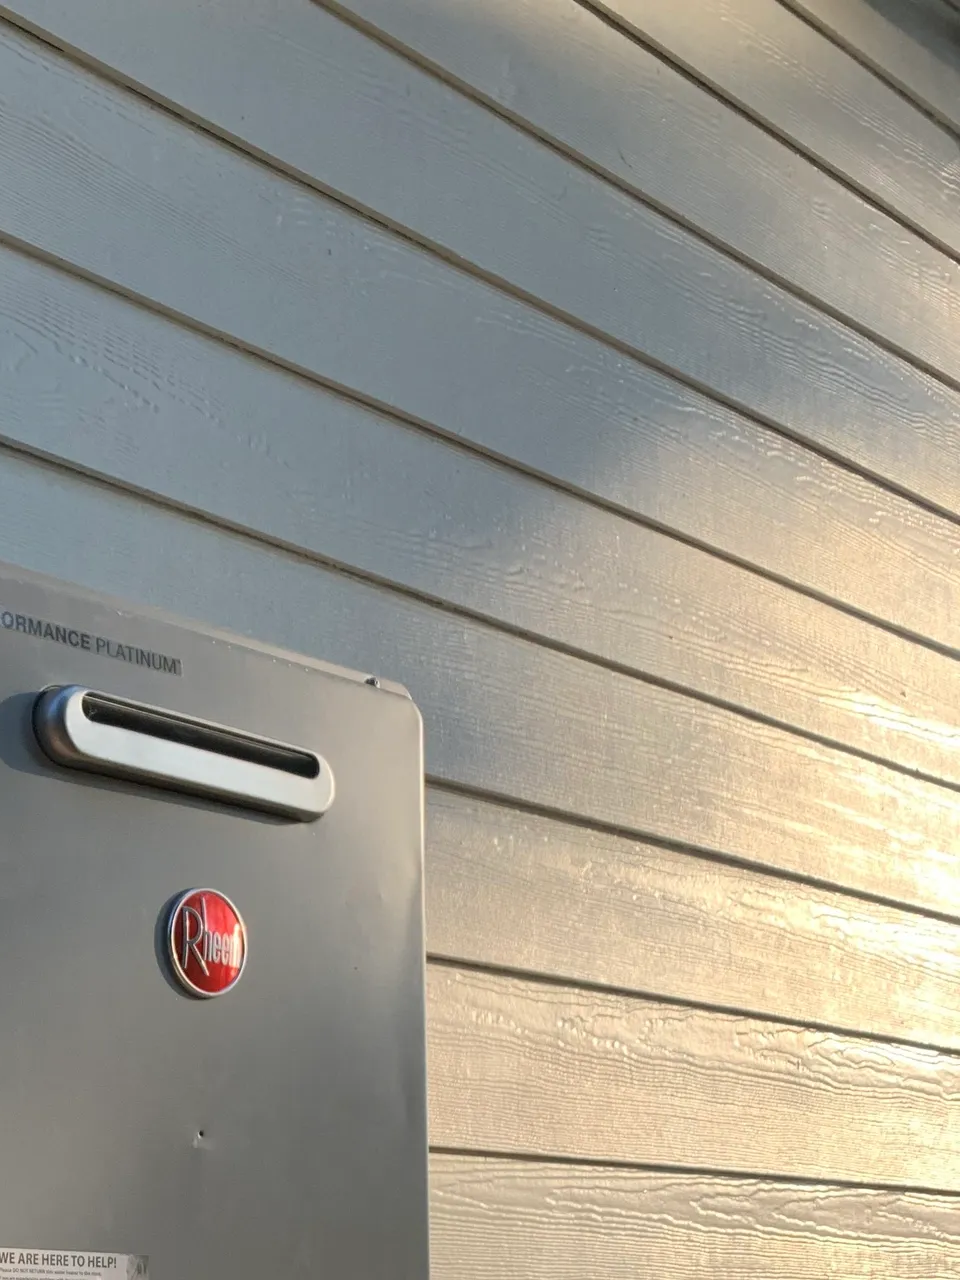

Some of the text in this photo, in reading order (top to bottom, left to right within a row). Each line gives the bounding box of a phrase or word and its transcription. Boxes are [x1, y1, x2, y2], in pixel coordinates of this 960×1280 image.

[18, 1252, 39, 1266] ARE
[42, 1253, 69, 1267] HERE
[71, 1255, 85, 1268] TO
[87, 1255, 117, 1269] HELP!
